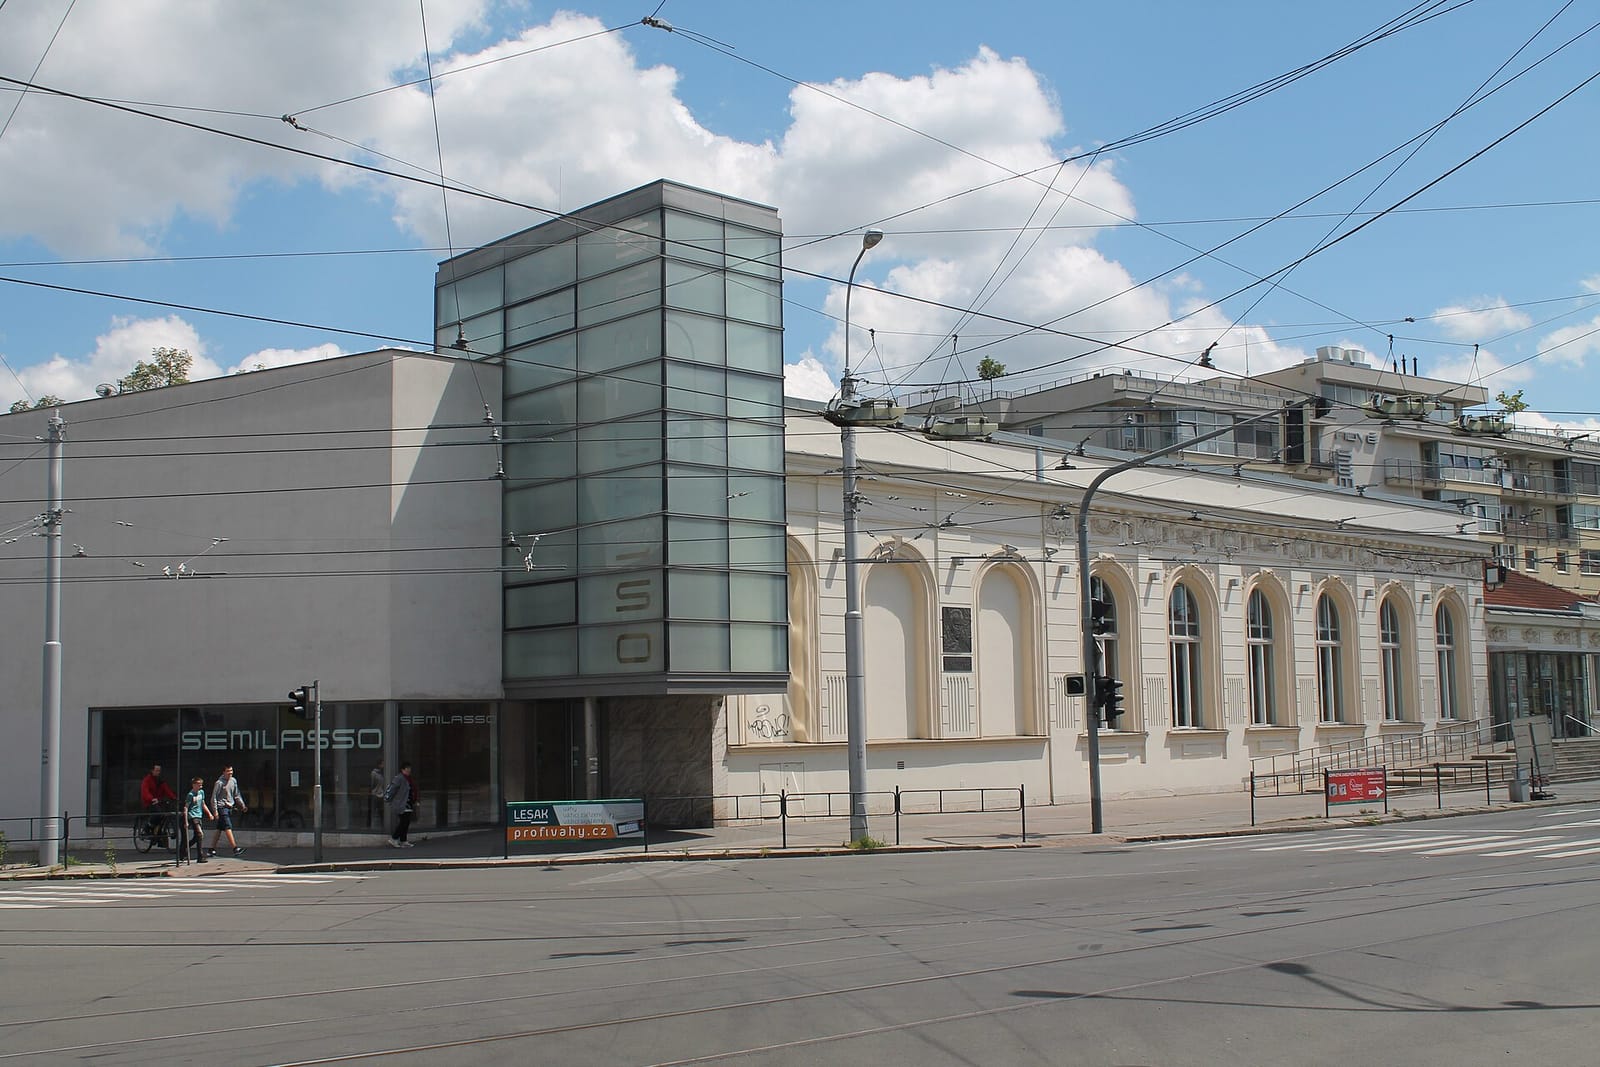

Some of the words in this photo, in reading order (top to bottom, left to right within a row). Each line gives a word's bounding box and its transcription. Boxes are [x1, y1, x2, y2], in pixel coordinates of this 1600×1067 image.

[400, 715, 497, 725] SEMILASSO
[182, 728, 382, 750] SEMILASSO
[514, 809, 549, 820] LESAK
[514, 826, 608, 840] profivahy.cz
